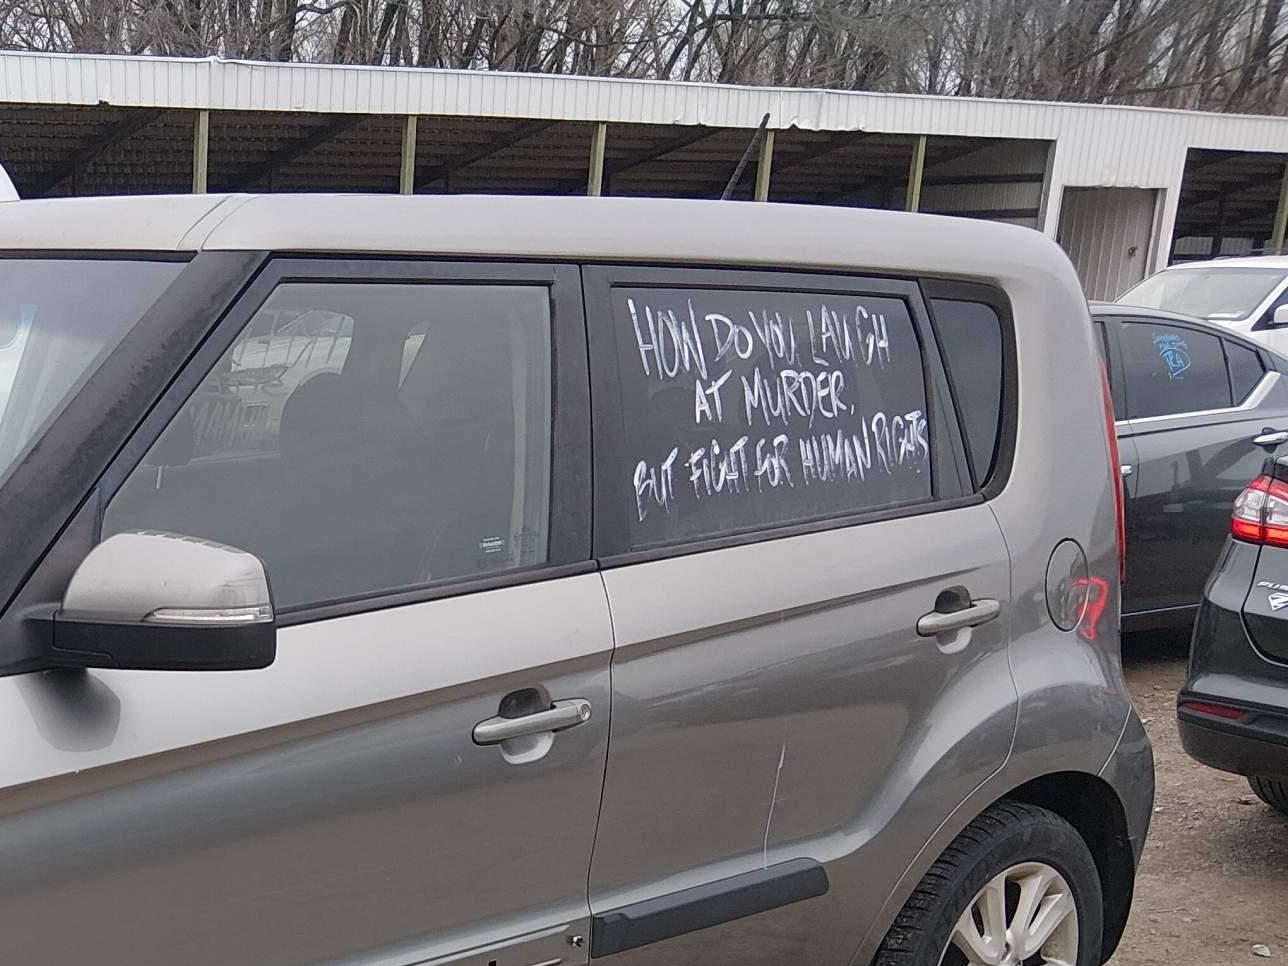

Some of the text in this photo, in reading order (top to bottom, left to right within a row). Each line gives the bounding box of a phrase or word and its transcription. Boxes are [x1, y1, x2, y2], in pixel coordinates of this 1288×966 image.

[628, 298, 891, 381] HOW DO YOU LAUGH
[695, 369, 733, 424] AT
[633, 447, 678, 521] BUT
[800, 416, 871, 486] HUMAN
